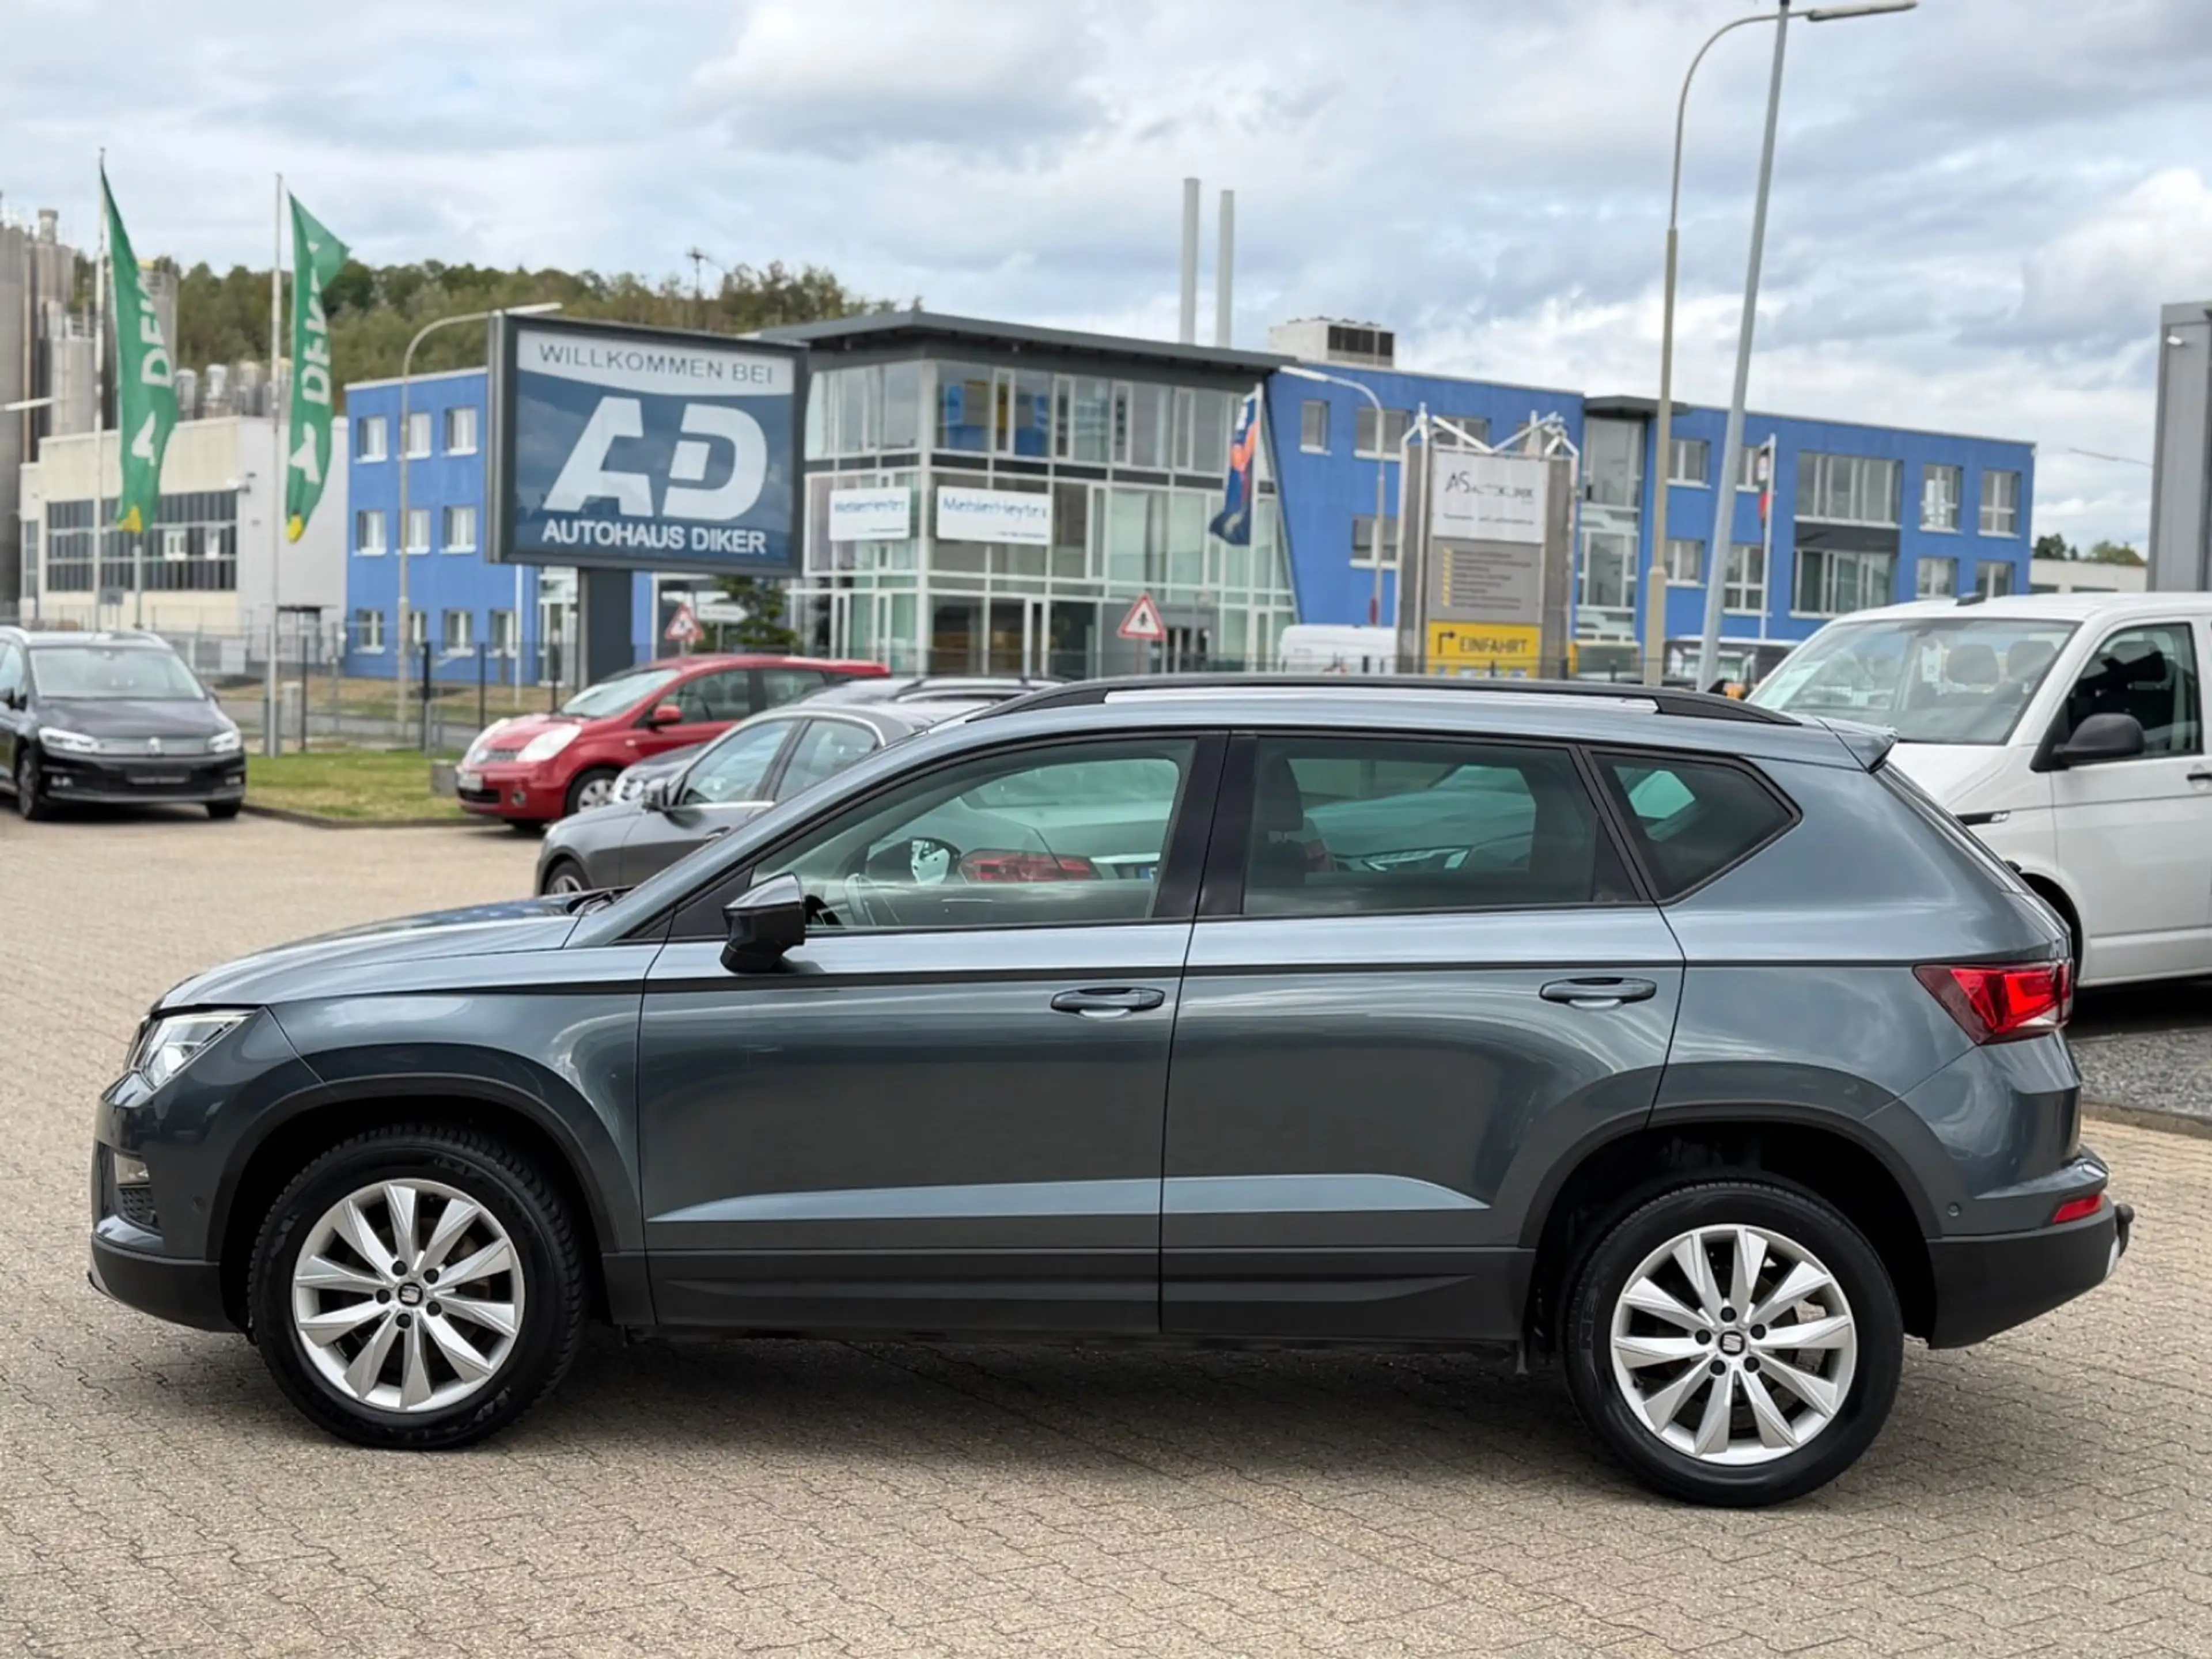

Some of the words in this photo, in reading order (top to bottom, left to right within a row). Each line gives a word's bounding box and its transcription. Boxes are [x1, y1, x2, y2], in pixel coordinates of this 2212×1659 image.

[539, 343, 724, 379] WILLKOMMEN
[732, 363, 773, 384] BEI
[542, 396, 768, 521] AD
[541, 518, 685, 550] AUTOHAUS
[691, 526, 767, 554] DIKER
[1459, 635, 1528, 653] EINFAHRT
